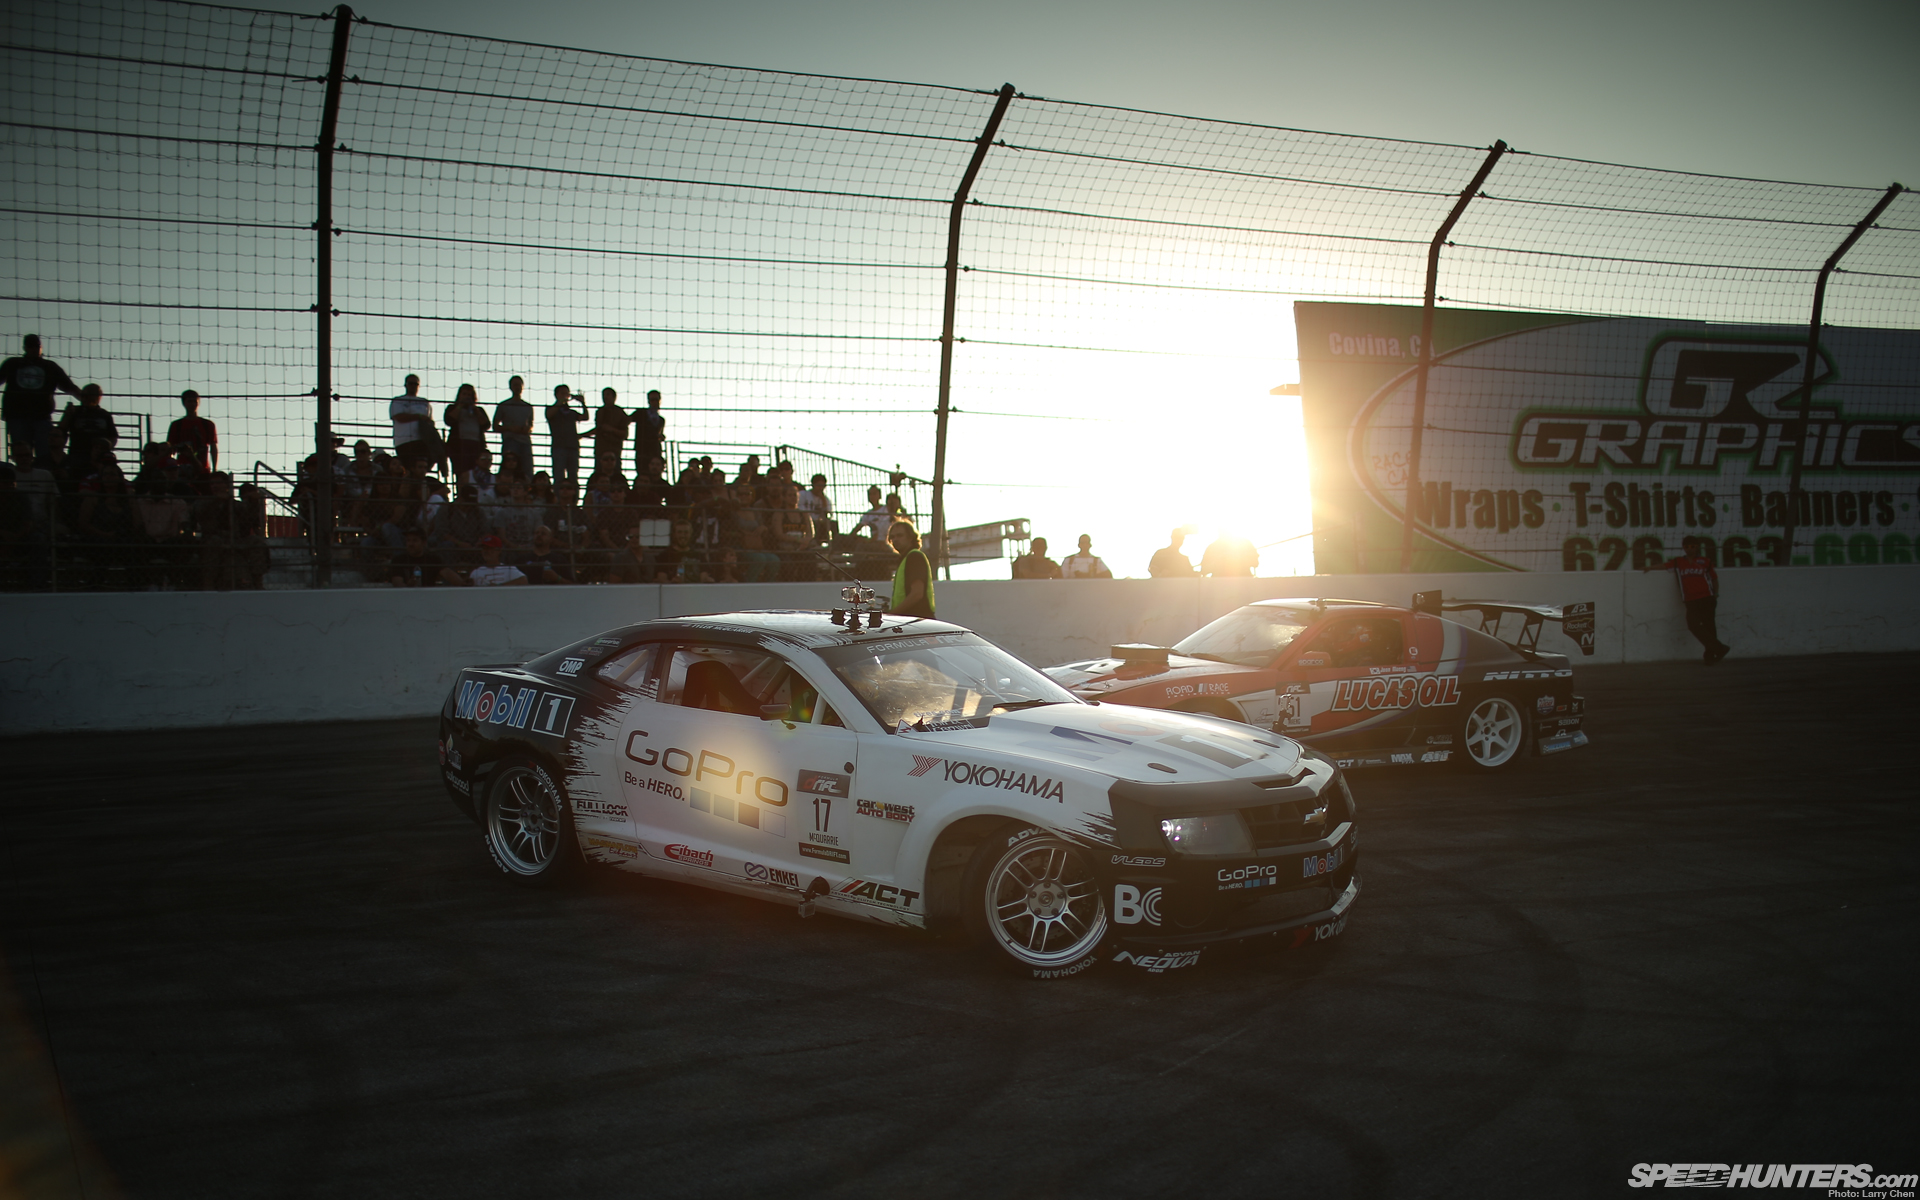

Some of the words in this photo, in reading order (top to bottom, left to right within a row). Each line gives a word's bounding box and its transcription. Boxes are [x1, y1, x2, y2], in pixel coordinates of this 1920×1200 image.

[1328, 331, 1406, 359] Covina,
[1411, 481, 1545, 534] Wraps
[1569, 481, 1717, 529] T-Shirts
[1740, 483, 1896, 528] Banners
[866, 638, 930, 654] FORMULA
[559, 660, 583, 674] OMP
[1483, 669, 1573, 682] NITTO
[1165, 685, 1194, 695] ROAD
[1208, 682, 1229, 692] RACE
[1331, 675, 1418, 712] LUCAS
[1418, 674, 1462, 708] OIL
[455, 680, 538, 729] Mobil
[545, 698, 562, 731] 1
[625, 730, 789, 807] GoPro
[1336, 759, 1354, 767] CT
[535, 763, 563, 812] YOKOHAMA
[625, 771, 637, 786] Be
[638, 778, 645, 788] a
[647, 777, 685, 801] HERO.
[944, 759, 1064, 803] YOKOHAMA
[812, 797, 832, 833] 17
[856, 799, 876, 809] car
[884, 804, 916, 816] west
[856, 808, 884, 818] AUTO
[886, 812, 916, 823] BODY
[664, 843, 714, 861] Eibach
[769, 868, 800, 888] ENKEI
[1217, 865, 1277, 882] GoPro
[850, 882, 920, 907] ACT
[1114, 883, 1163, 927] BC
[1112, 951, 1200, 969] NEOVA
[1163, 950, 1202, 958] ADVAN
[1033, 955, 1097, 980] YOKOHAMA
